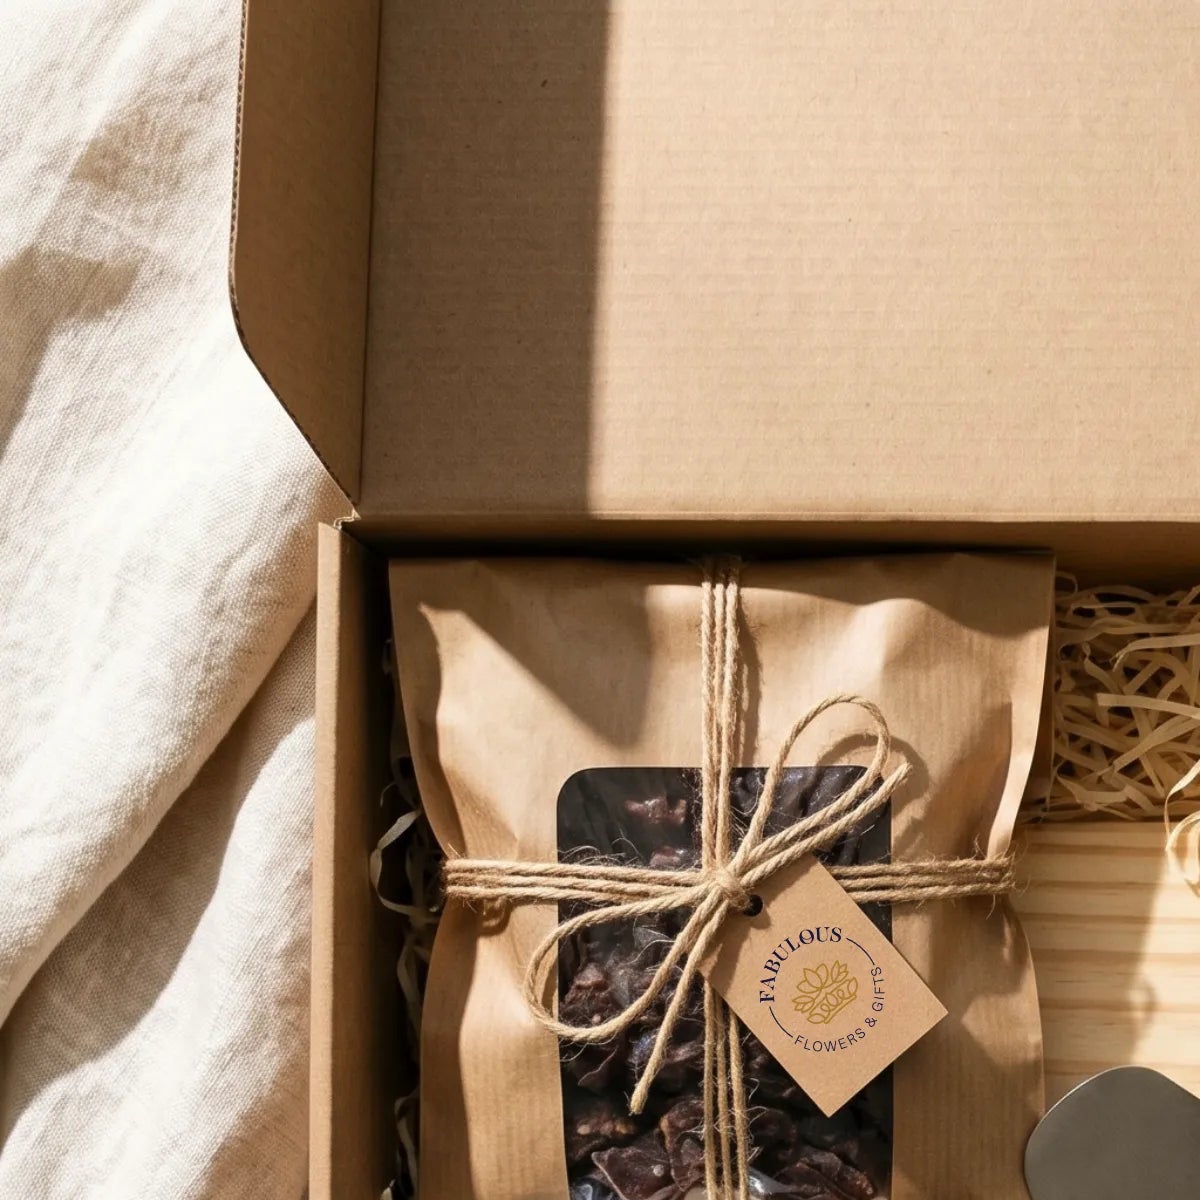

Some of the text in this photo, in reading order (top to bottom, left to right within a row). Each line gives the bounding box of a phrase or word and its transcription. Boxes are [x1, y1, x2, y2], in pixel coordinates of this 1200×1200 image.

[759, 926, 842, 1003] FABULOUS
[795, 966, 885, 1052] FLOWERS & GIFTS
